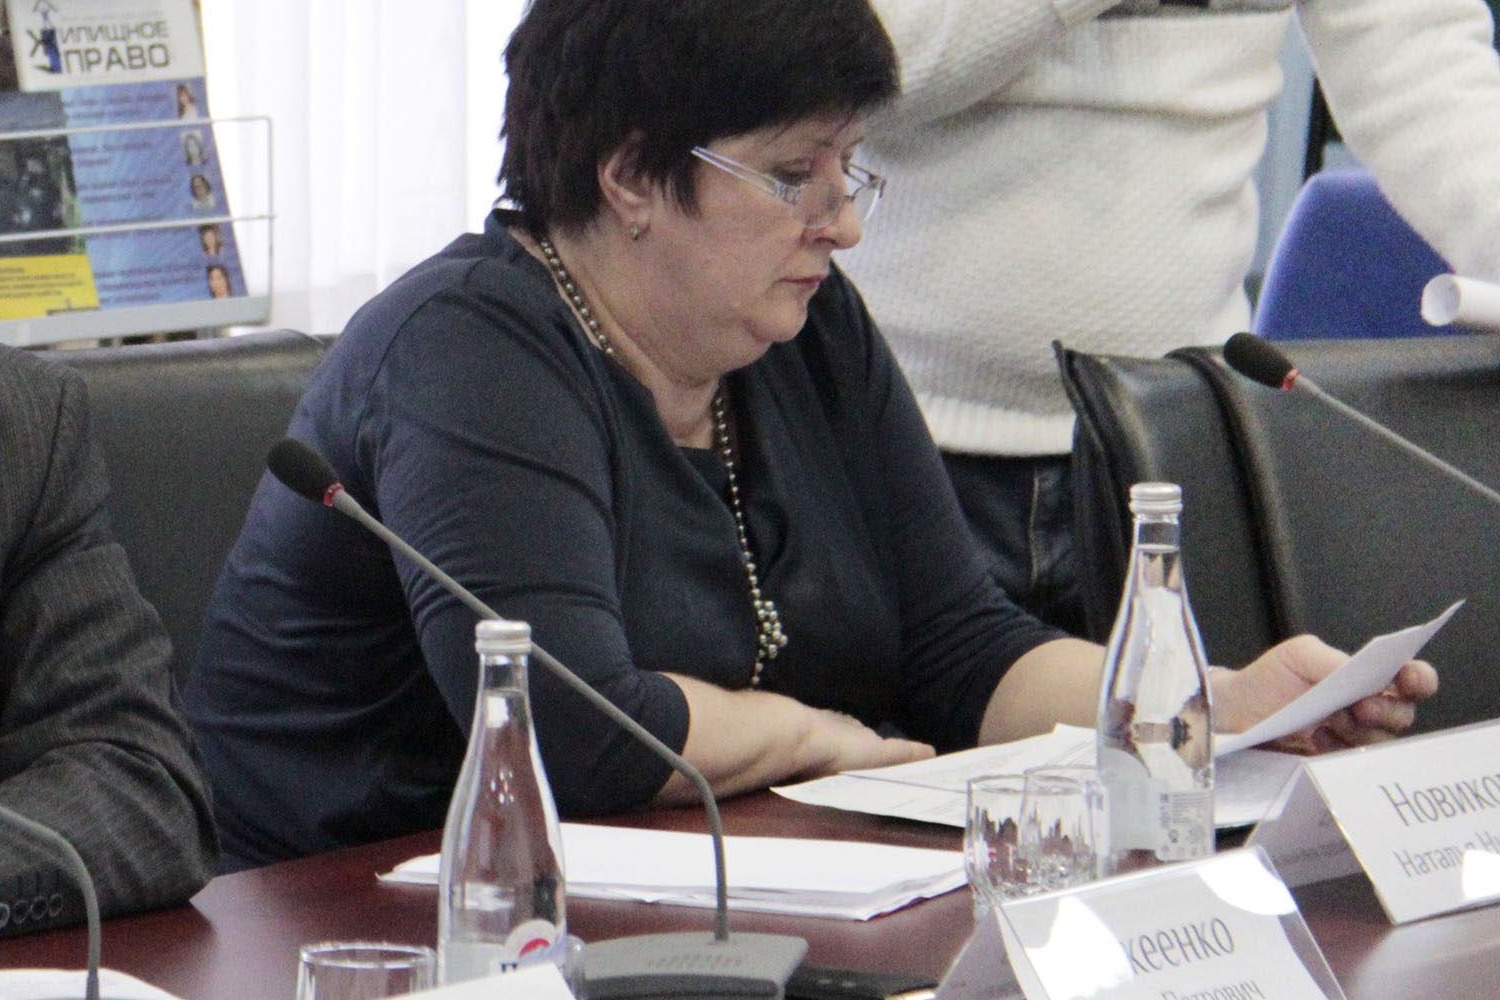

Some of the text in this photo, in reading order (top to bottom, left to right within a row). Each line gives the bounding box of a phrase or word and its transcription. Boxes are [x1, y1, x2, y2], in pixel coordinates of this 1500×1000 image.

[63, 43, 170, 74] ПРАВО
[1378, 774, 1500, 827] Новико
[1119, 916, 1235, 975] кеенко
